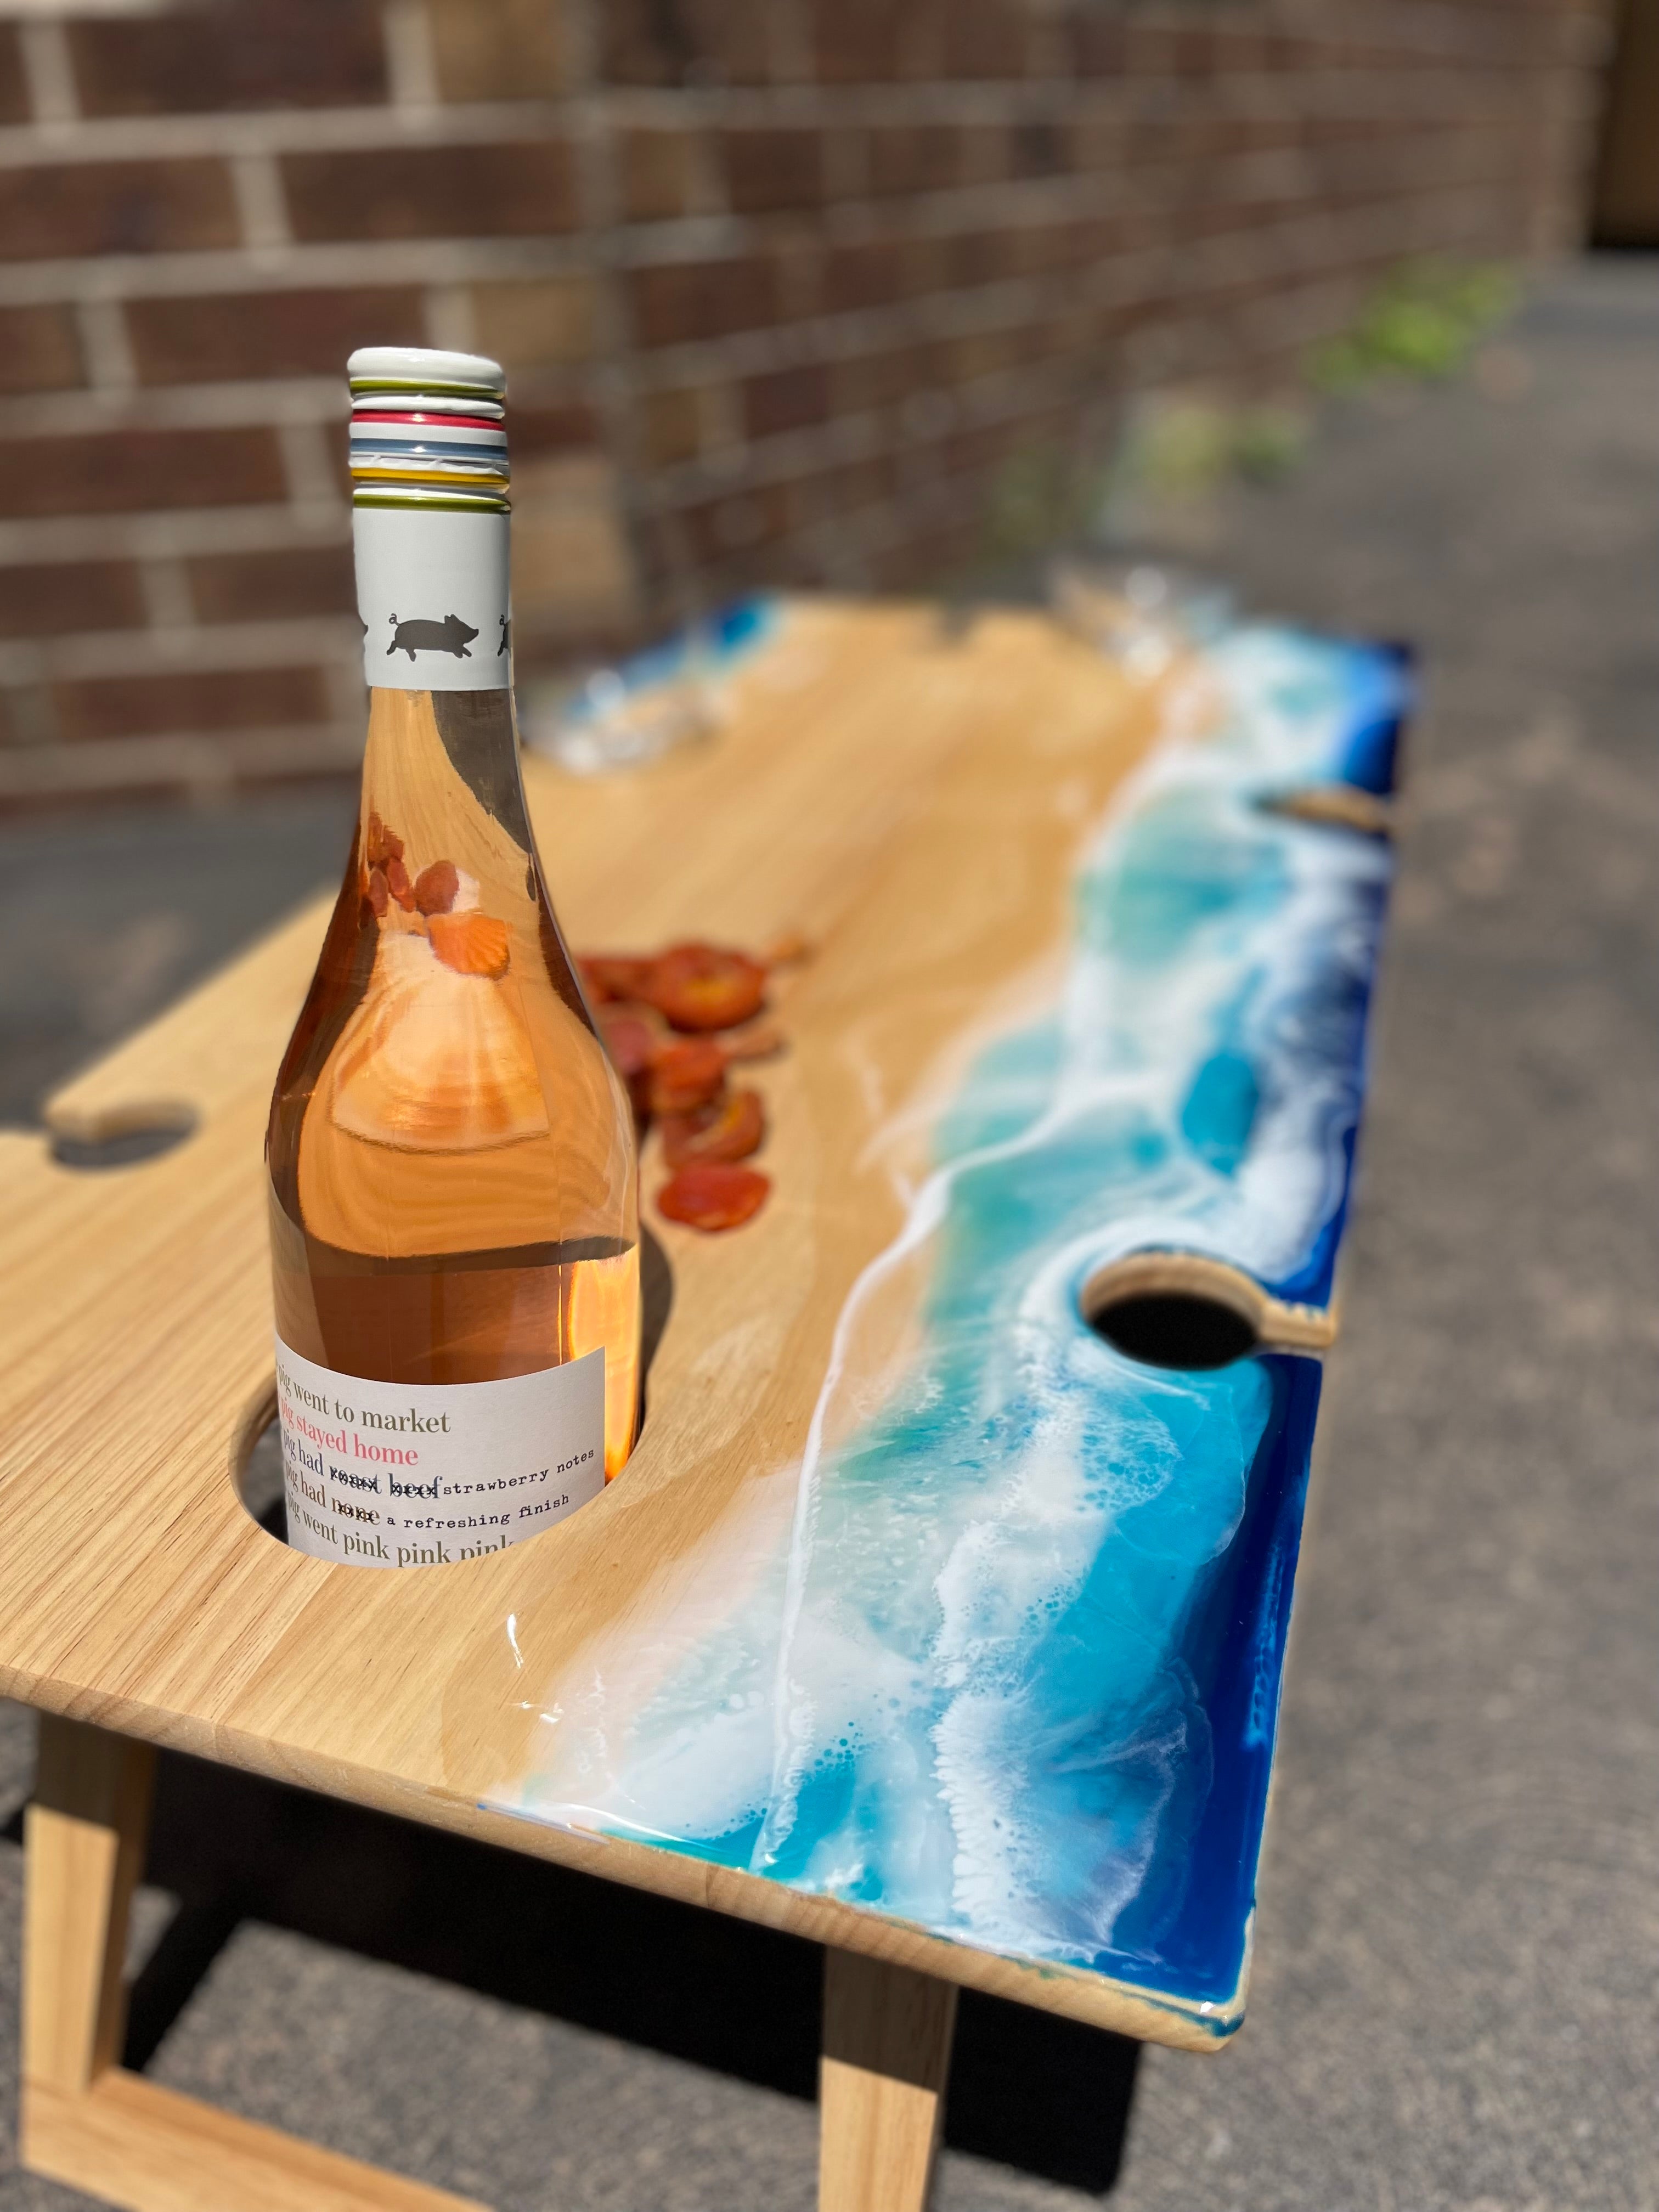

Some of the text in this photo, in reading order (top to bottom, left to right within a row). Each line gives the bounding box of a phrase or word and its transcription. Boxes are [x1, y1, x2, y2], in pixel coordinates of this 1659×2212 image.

[293, 1381, 330, 1415] went
[334, 1398, 355, 1423] to
[362, 1408, 451, 1432] market
[283, 1428, 296, 1461] pig
[298, 1438, 325, 1476] had
[443, 1469, 549, 1494] strawberry
[556, 1449, 594, 1473] notes
[296, 1415, 348, 1454] stayed
[354, 1434, 418, 1465] home
[286, 1459, 298, 1492] pig
[300, 1470, 326, 1508] had
[387, 1517, 396, 1525] a
[404, 1513, 510, 1528] refreshing
[518, 1494, 569, 1518] finish
[288, 1491, 301, 1523] pig
[302, 1509, 338, 1544] went
[343, 1532, 391, 1560] pink
[397, 1541, 450, 1567] pink
